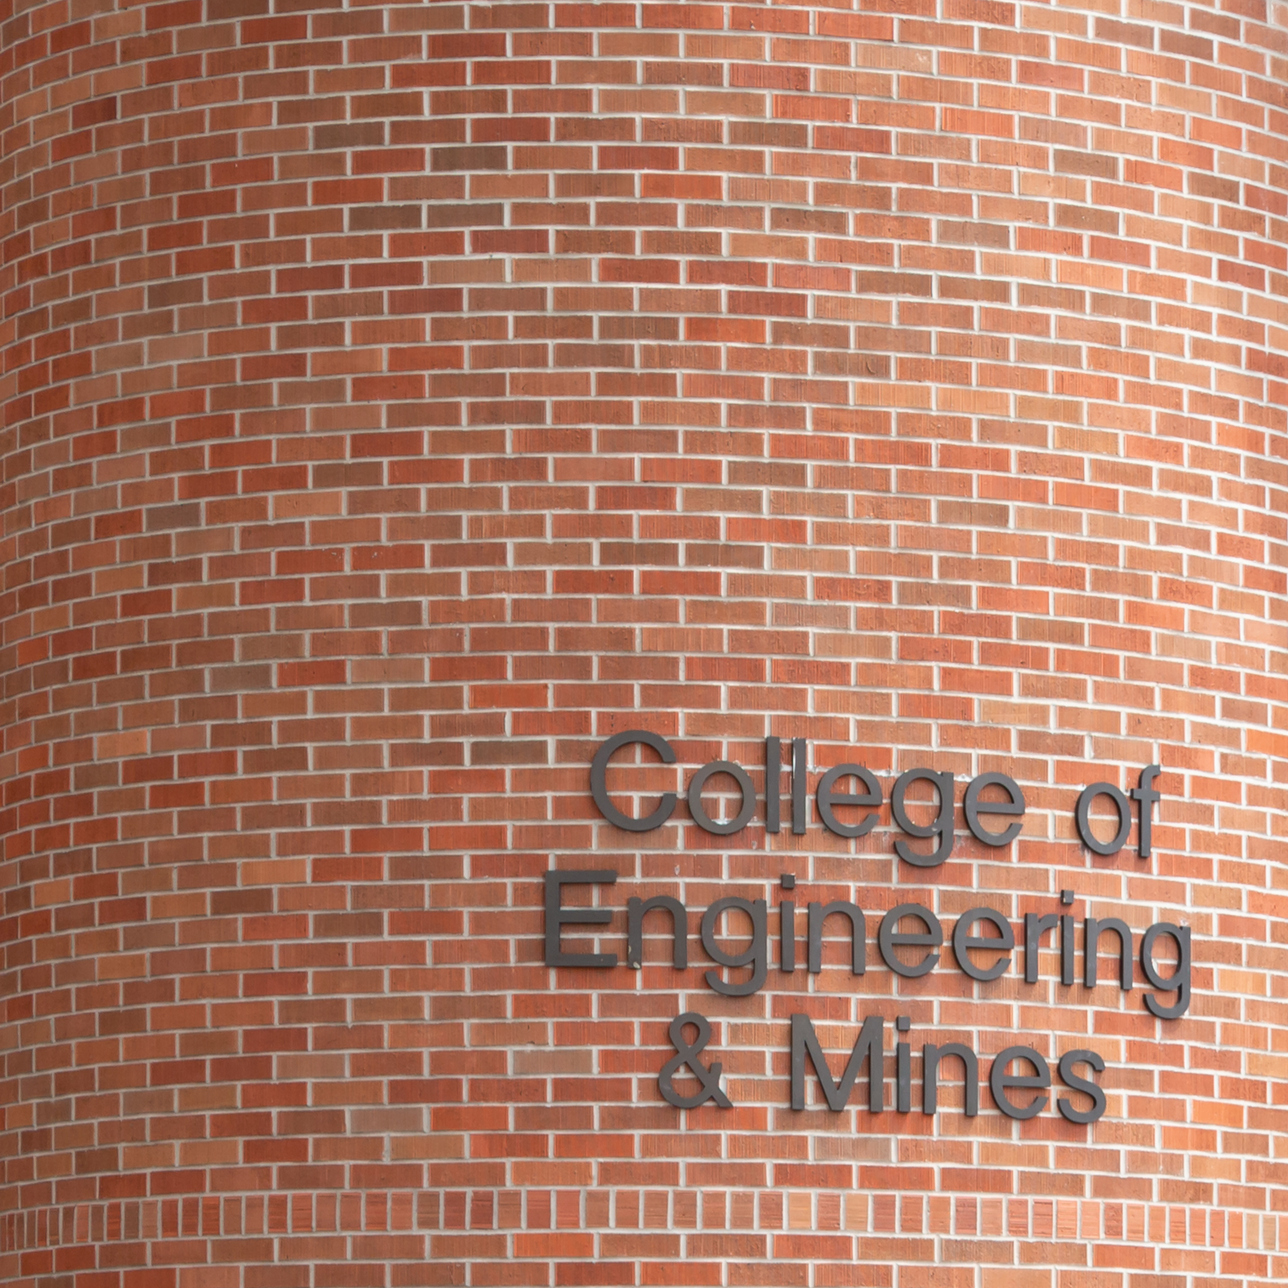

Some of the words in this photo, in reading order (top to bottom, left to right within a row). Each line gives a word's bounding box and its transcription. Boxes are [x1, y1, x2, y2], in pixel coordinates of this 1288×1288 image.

[590, 729, 1025, 867] College
[1075, 764, 1161, 858] of
[544, 869, 1192, 1021] Engineering
[658, 1011, 734, 1109] &
[790, 1013, 1107, 1124] Mines
